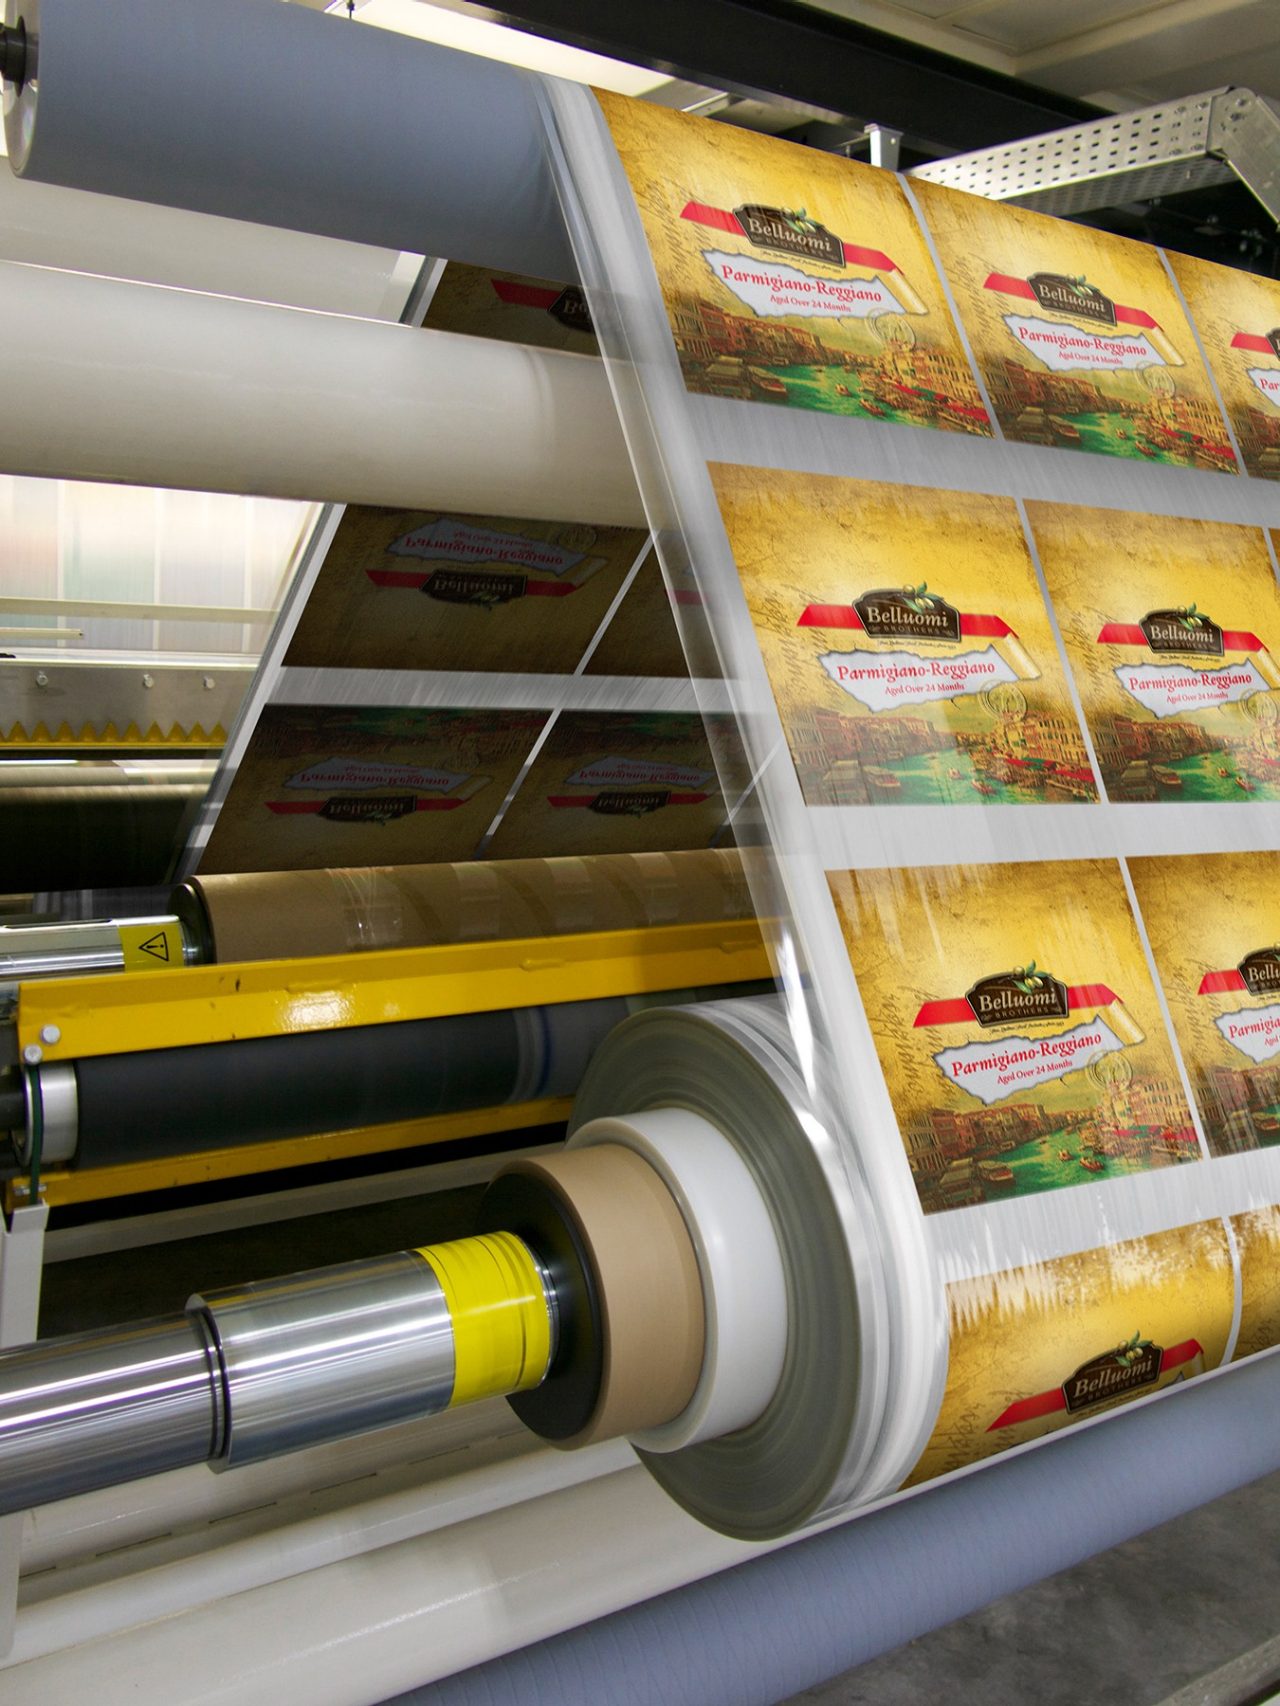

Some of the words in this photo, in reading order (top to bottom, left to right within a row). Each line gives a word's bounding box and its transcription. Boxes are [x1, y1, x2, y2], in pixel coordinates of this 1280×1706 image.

[748, 217, 833, 251] Belluomi
[720, 264, 882, 302] Parmigiano-Reggiano
[770, 294, 790, 306] Aged
[791, 297, 810, 307] Over
[811, 299, 823, 309] 24
[824, 300, 852, 313] Months
[1038, 284, 1106, 312] Belluomi
[1018, 326, 1147, 357] Parmigiano-Reggiano
[1058, 351, 1075, 361] Aged
[866, 606, 949, 627] Belluomi
[1149, 624, 1214, 644] Belluomi
[836, 659, 996, 683] Parmigiano-Reggiano
[1128, 672, 1253, 692] Parmigiano-Reggiano
[885, 685, 904, 697] Aged
[904, 684, 924, 694] Over
[925, 683, 936, 692] 24
[937, 682, 965, 692] Months
[1166, 694, 1182, 704] Aged
[1206, 692, 1229, 701] Months
[978, 987, 1058, 1013] Belluomi
[995, 1006, 1049, 1019] BROTHERS
[951, 1033, 1102, 1078] Parmigiano-Reggiano
[997, 1073, 1016, 1086] Aged
[1016, 1069, 1035, 1081] Over
[1035, 1065, 1046, 1076] 24
[1046, 1059, 1073, 1073] Months
[1072, 1354, 1154, 1399] Belluomi
